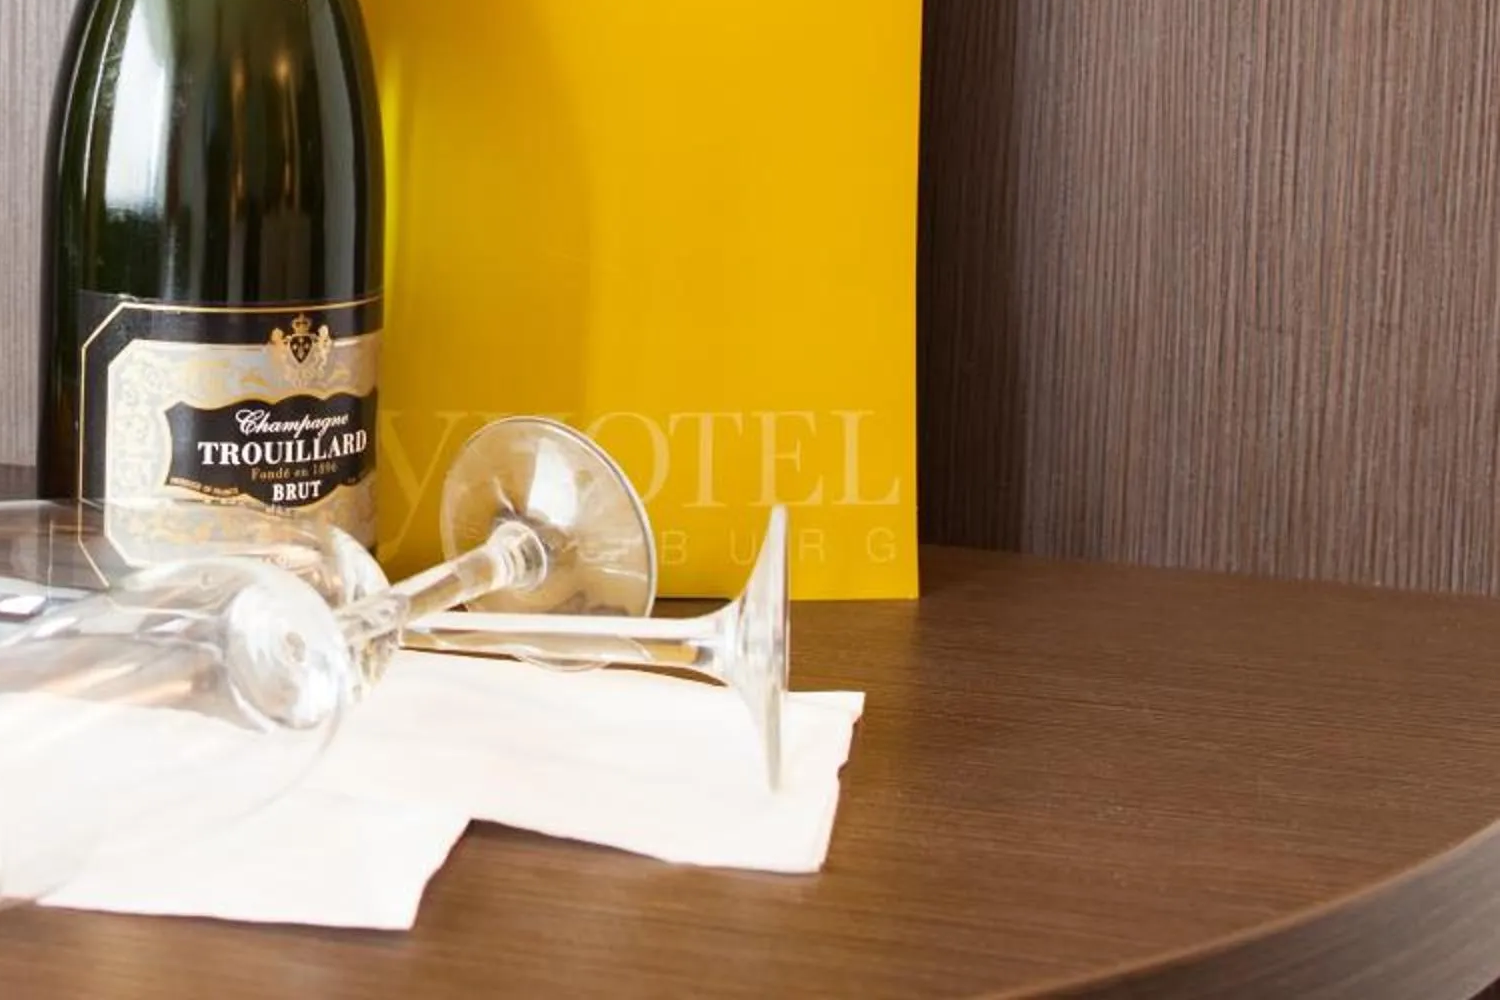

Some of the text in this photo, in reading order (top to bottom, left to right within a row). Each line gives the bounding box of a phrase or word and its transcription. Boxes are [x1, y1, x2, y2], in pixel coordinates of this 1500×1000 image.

[235, 409, 349, 440] Champagne
[197, 429, 368, 466] TROUILLARD
[272, 479, 322, 502] BRUT
[660, 526, 897, 566] BURG
